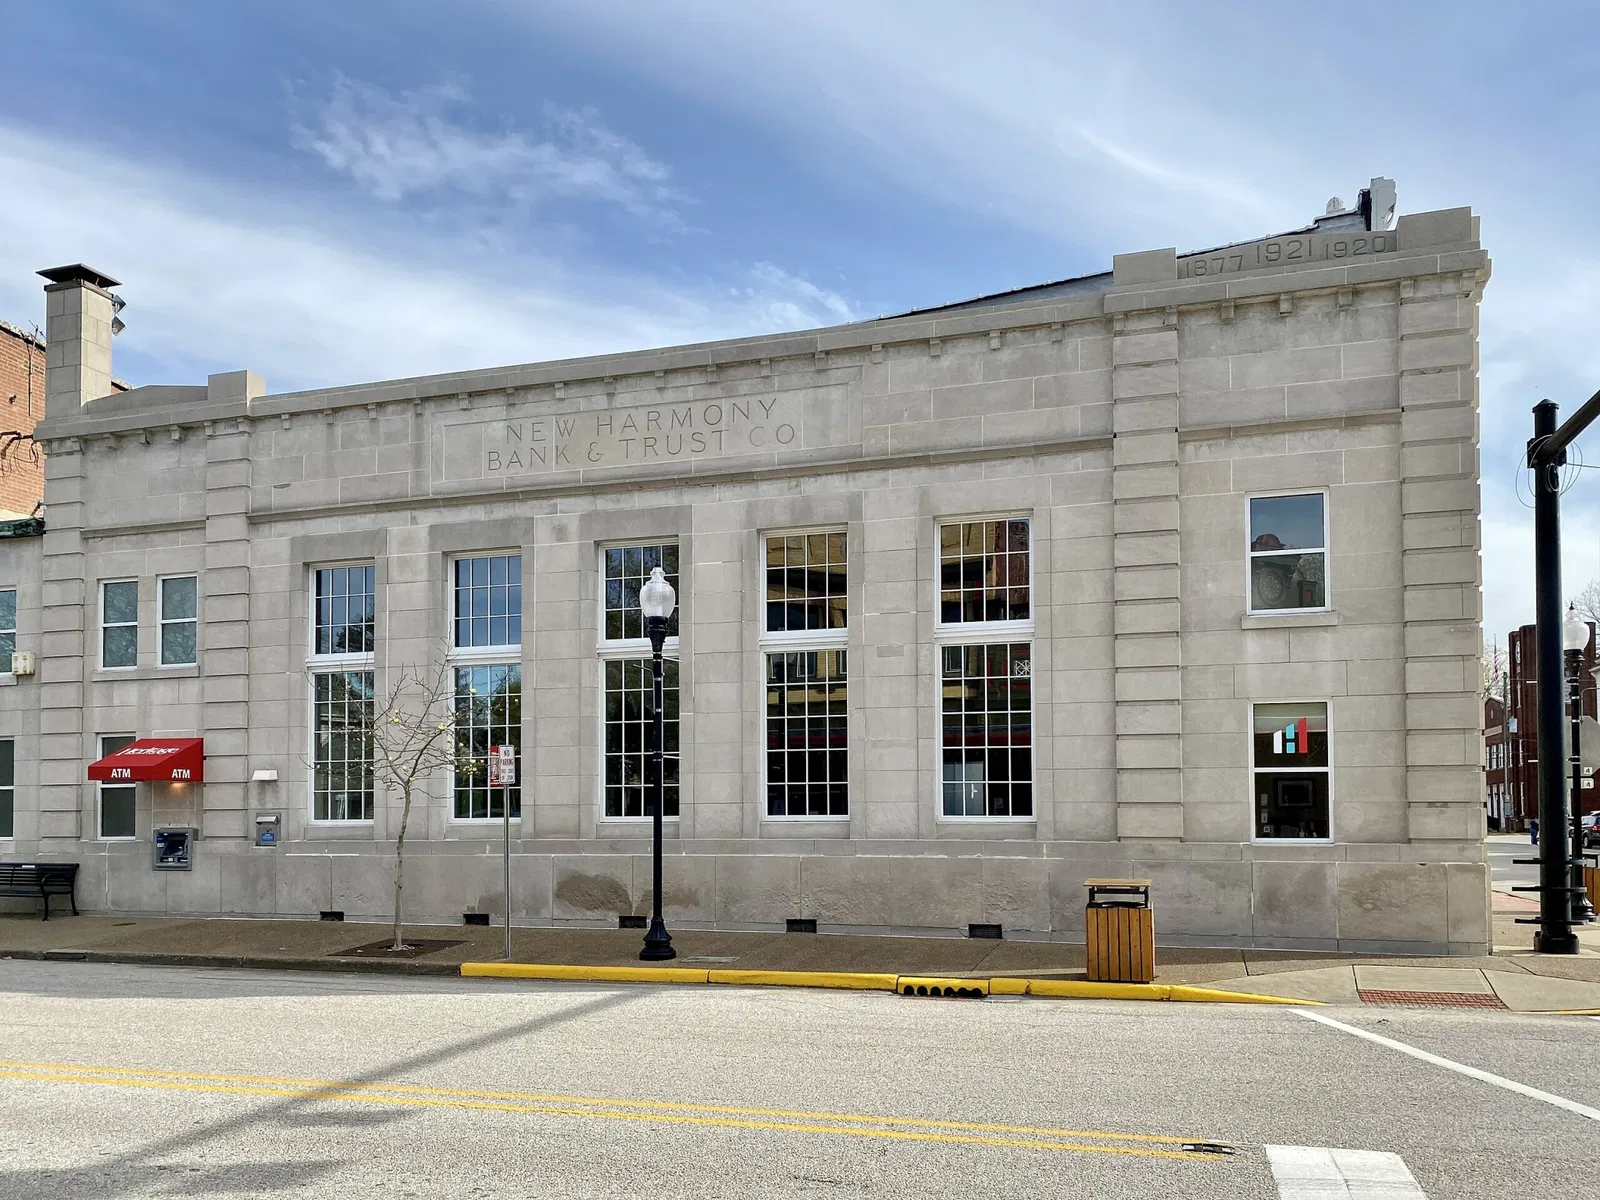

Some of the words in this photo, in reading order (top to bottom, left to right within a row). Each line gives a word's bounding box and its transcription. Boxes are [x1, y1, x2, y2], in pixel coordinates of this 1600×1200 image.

[1186, 254, 1244, 278] 1877
[1256, 238, 1312, 264] 1921
[1325, 235, 1387, 261] 1920
[506, 418, 576, 445] NEW
[596, 397, 777, 436] HARMONY
[487, 445, 571, 471] BANK
[587, 441, 604, 463] &
[618, 429, 730, 459] TRUST
[749, 423, 796, 447] CO
[111, 768, 131, 779] ATM
[171, 768, 191, 779] ATM
